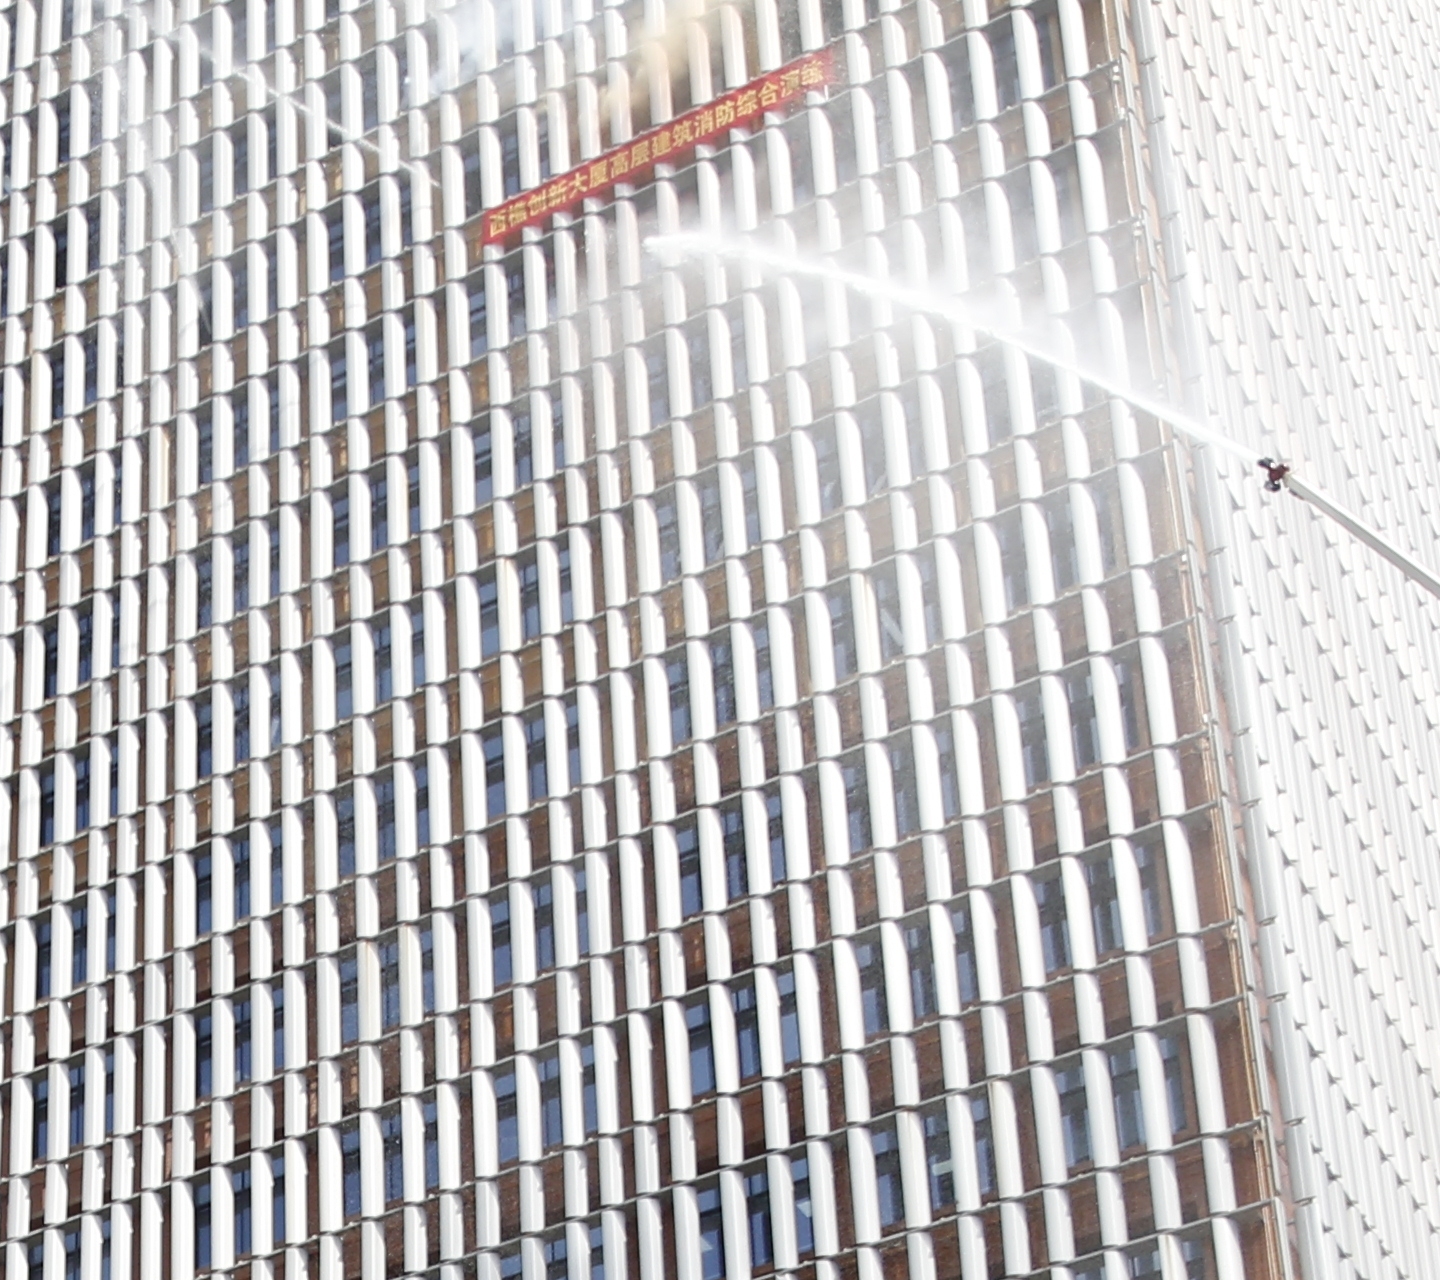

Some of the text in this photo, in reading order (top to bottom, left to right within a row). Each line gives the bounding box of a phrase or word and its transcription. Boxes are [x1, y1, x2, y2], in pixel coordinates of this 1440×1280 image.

[489, 59, 824, 238] 西樵创新大厦高层建筑消防综合演练
